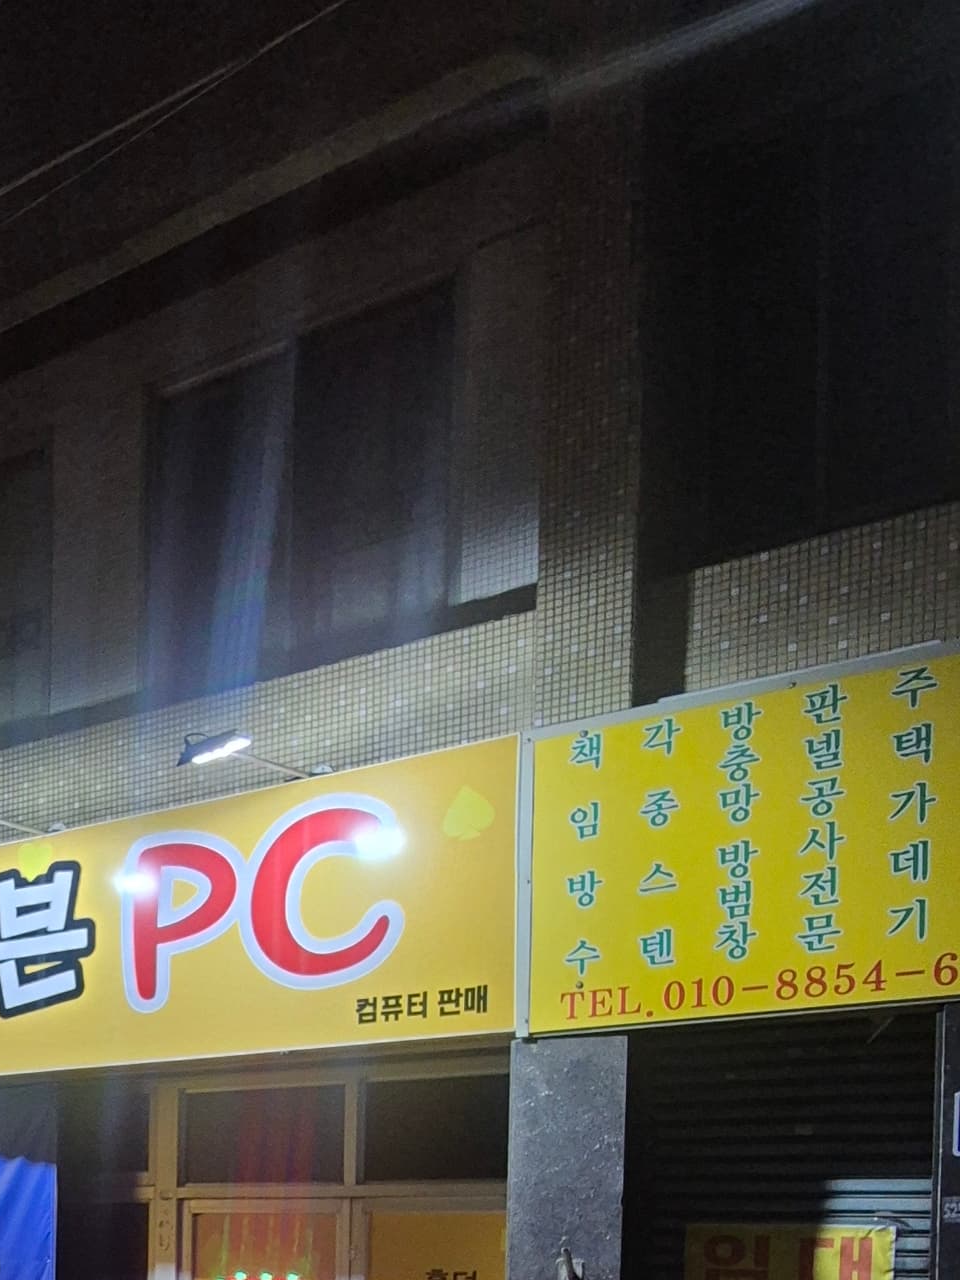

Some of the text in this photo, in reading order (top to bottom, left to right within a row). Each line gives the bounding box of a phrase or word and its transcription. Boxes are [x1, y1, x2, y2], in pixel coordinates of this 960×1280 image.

[119, 792, 406, 1013] PC
[354, 985, 488, 1025] 컴퓨터 판매
